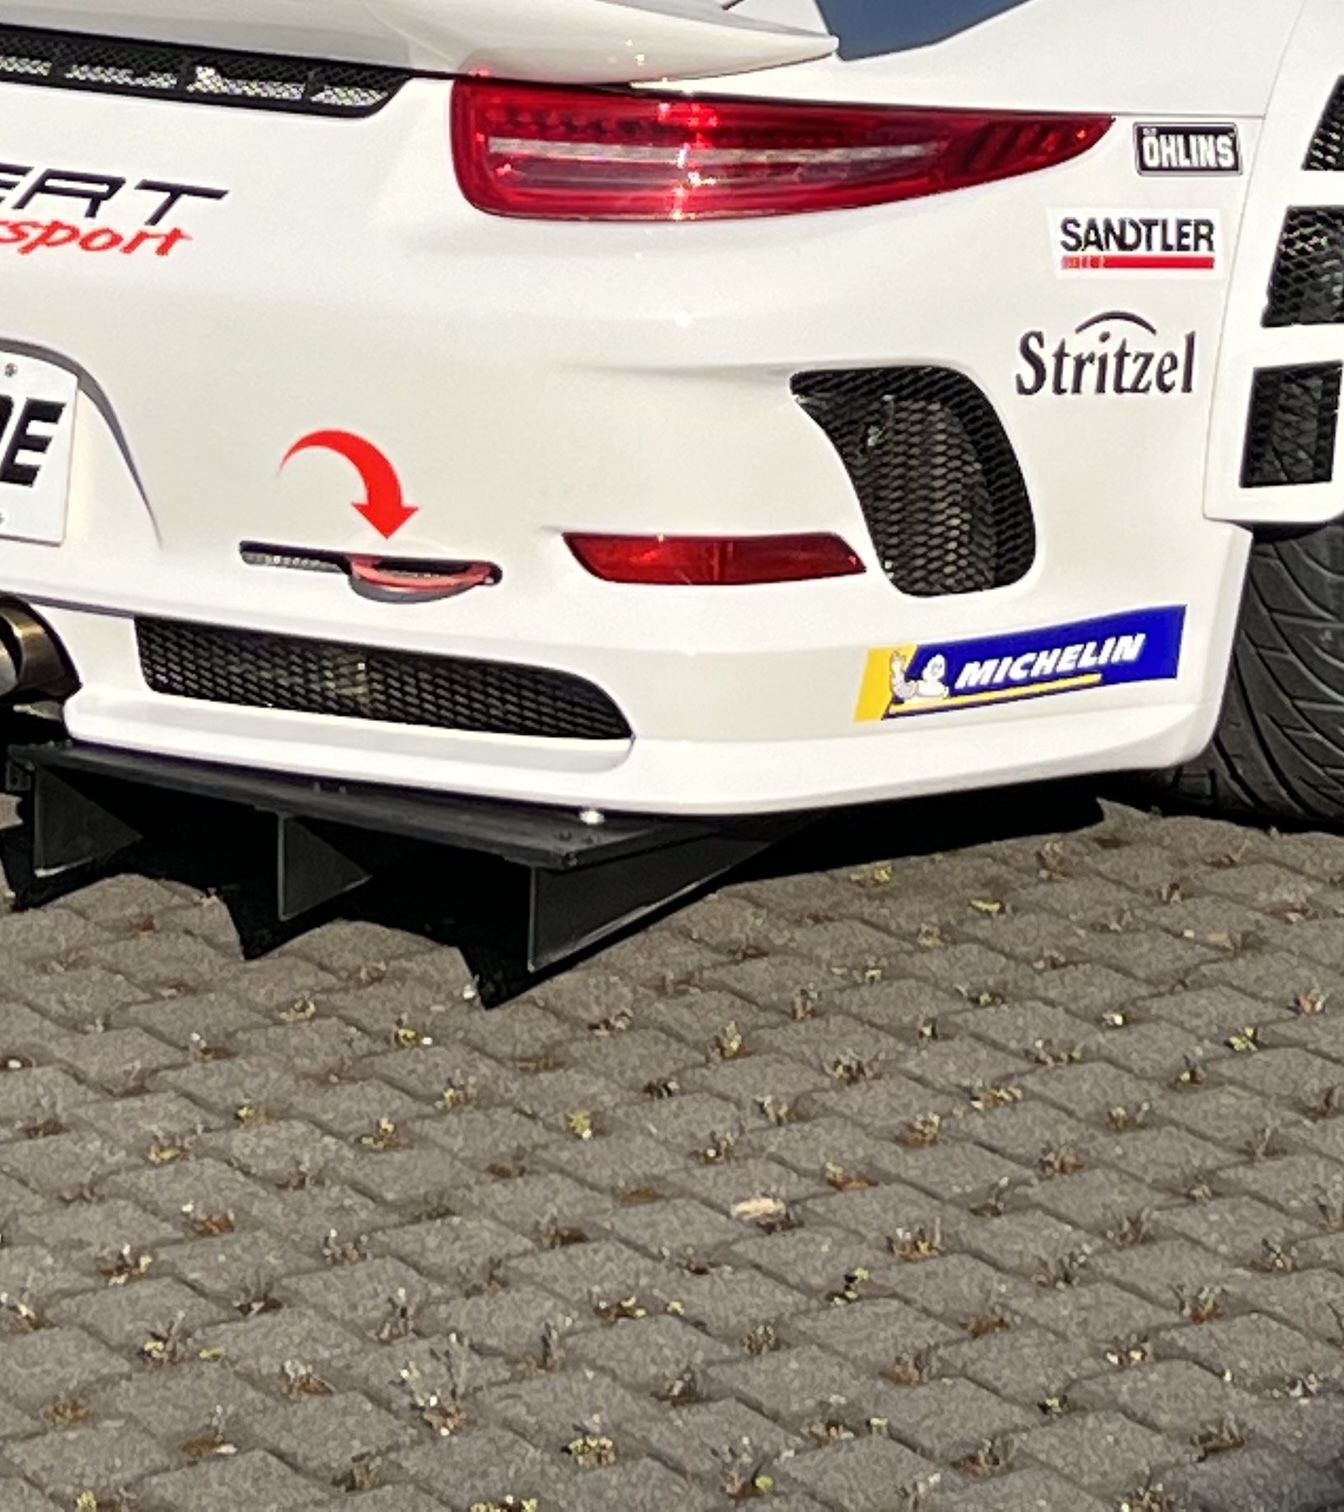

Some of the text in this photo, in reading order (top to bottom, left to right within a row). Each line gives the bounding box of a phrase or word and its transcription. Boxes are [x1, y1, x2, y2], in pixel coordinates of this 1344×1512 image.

[1142, 128, 1234, 168] ÖHLINS
[1060, 216, 1214, 253] SANDTLER
[1015, 329, 1195, 395] Stritzel
[955, 632, 1146, 689] MICHELIN
